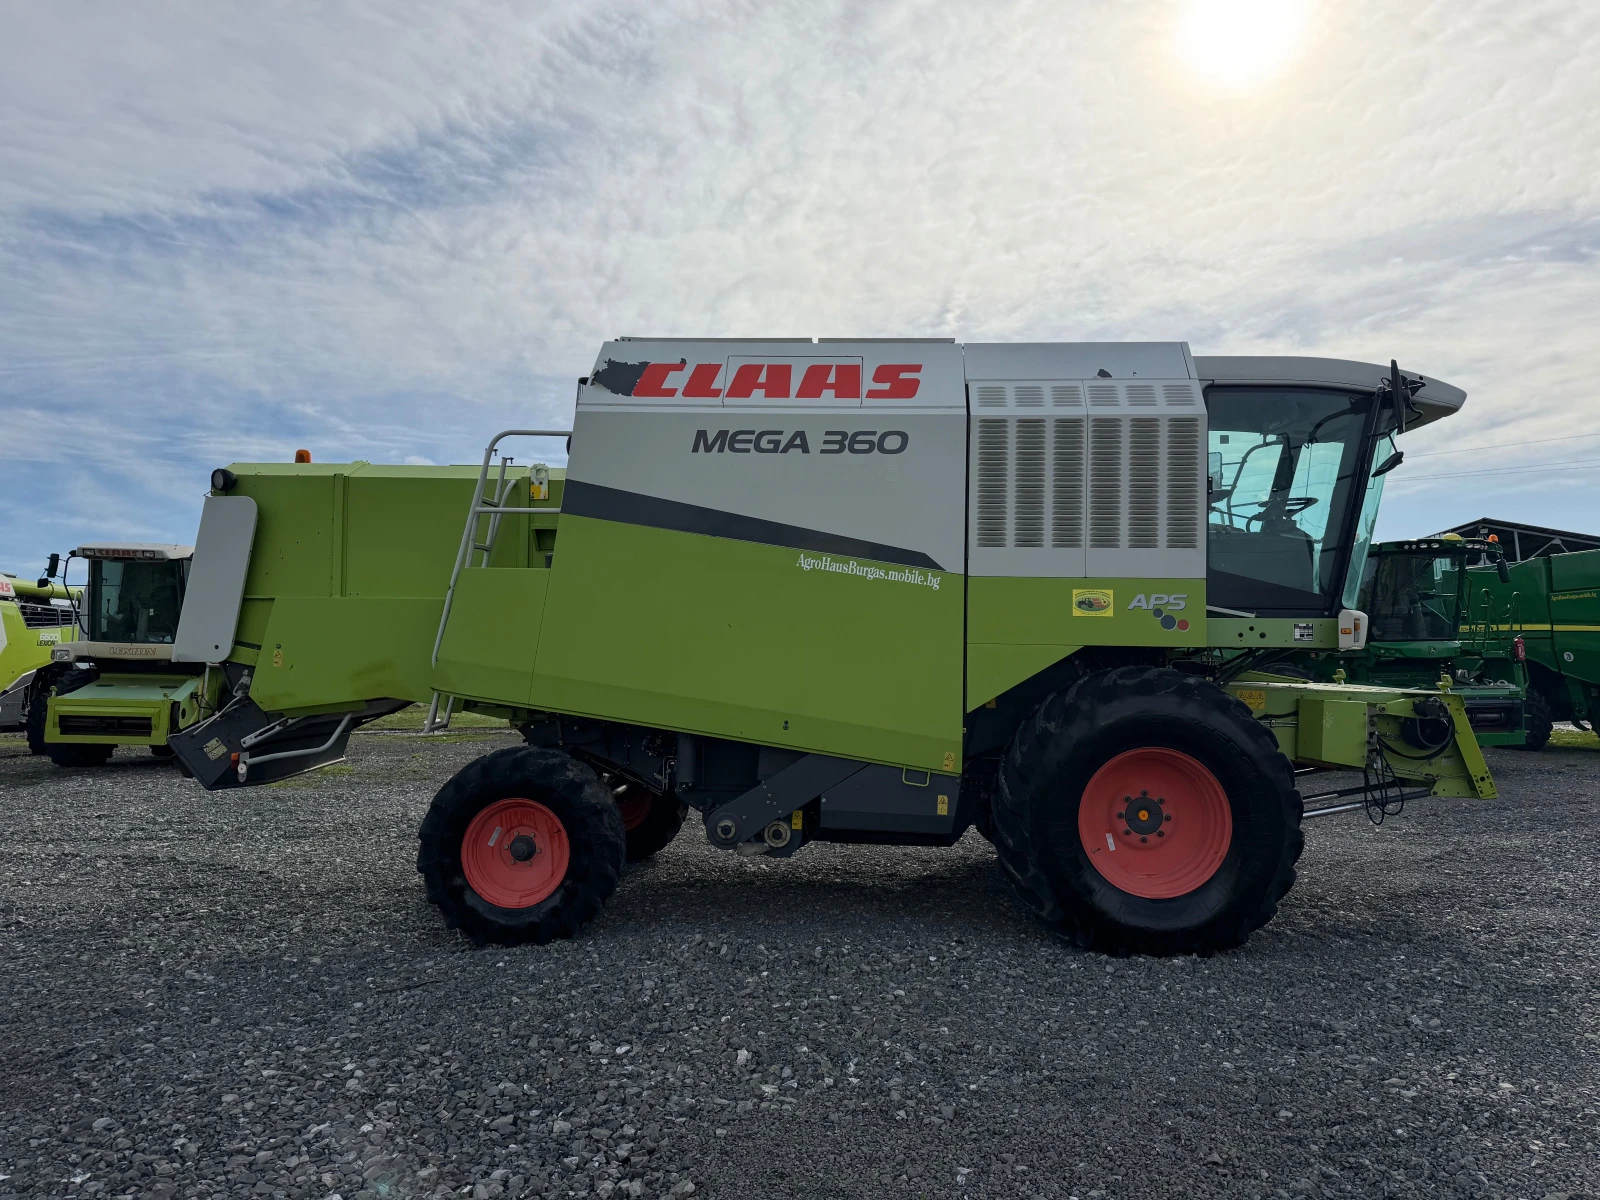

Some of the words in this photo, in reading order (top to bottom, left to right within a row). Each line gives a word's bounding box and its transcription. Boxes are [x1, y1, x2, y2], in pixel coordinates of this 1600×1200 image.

[632, 363, 923, 399] CLAAS
[691, 429, 811, 455] MEGA
[819, 429, 909, 455] 360
[796, 553, 941, 590] AgroHausBurgas.mobile.bg
[1127, 593, 1188, 610] APS
[109, 647, 157, 656] LEXION
